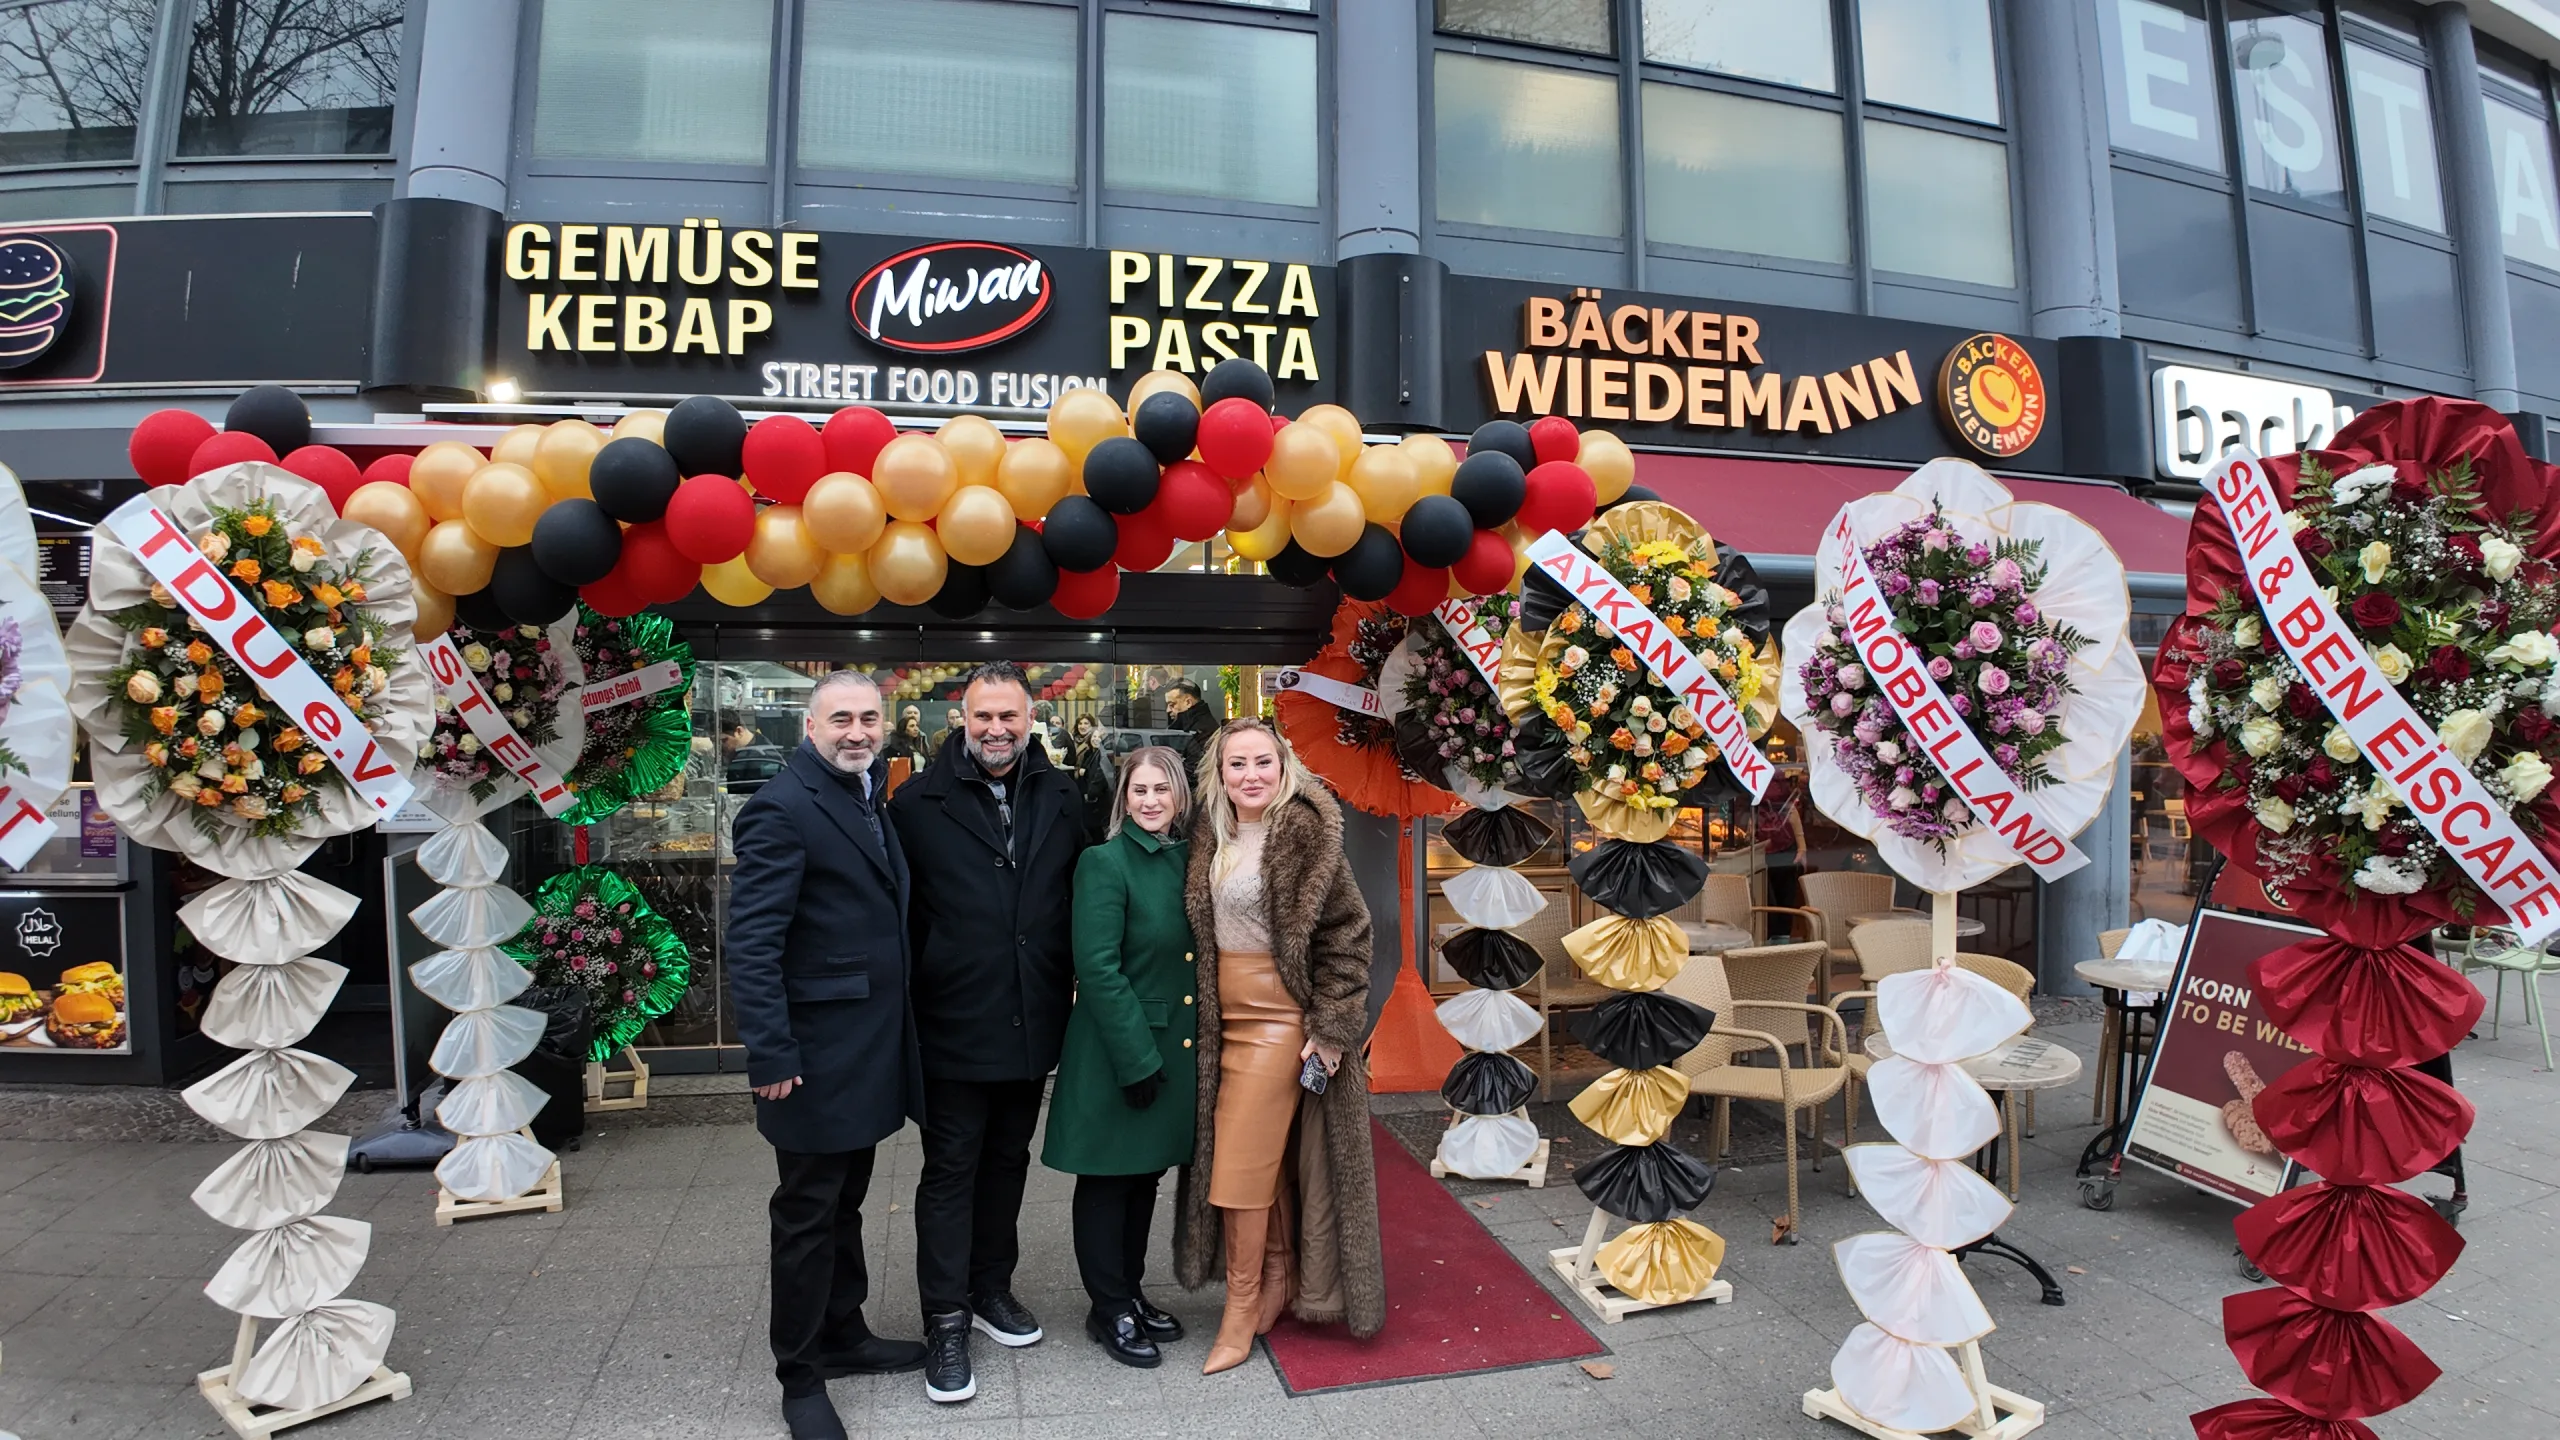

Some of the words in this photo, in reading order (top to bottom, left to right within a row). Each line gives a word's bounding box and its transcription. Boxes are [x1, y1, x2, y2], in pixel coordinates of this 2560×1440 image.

[505, 218, 819, 288] GEMÜSE
[1110, 250, 1319, 317] PIZZA
[527, 293, 773, 355] KEBAP
[869, 258, 1041, 340] Miwan
[1525, 287, 1764, 365] BÄCKER
[1110, 315, 1319, 381] PASTA
[1957, 341, 2032, 383] BÄCKER
[761, 361, 878, 400] STREET
[887, 366, 979, 404] FOOD
[1482, 350, 1922, 434] WIEDEMANN
[1953, 385, 2039, 449] WIEDEMANN
[2174, 379, 2360, 465] back
[2217, 460, 2279, 560] SEN
[2258, 556, 2294, 604] &
[2277, 596, 2384, 722] BEN
[138, 508, 298, 680] TDU
[303, 701, 397, 809] e.V.
[615, 676, 642, 698] GmbH
[1542, 552, 1688, 680] AYKAN
[1682, 675, 1767, 791] KÜTÜK
[1850, 597, 2066, 866] MÖBELLAND
[25, 935, 55, 944] HELAL
[2181, 1000, 2210, 1024] TO
[2216, 1010, 2249, 1036] BE
[2186, 975, 2252, 1009] KORN
